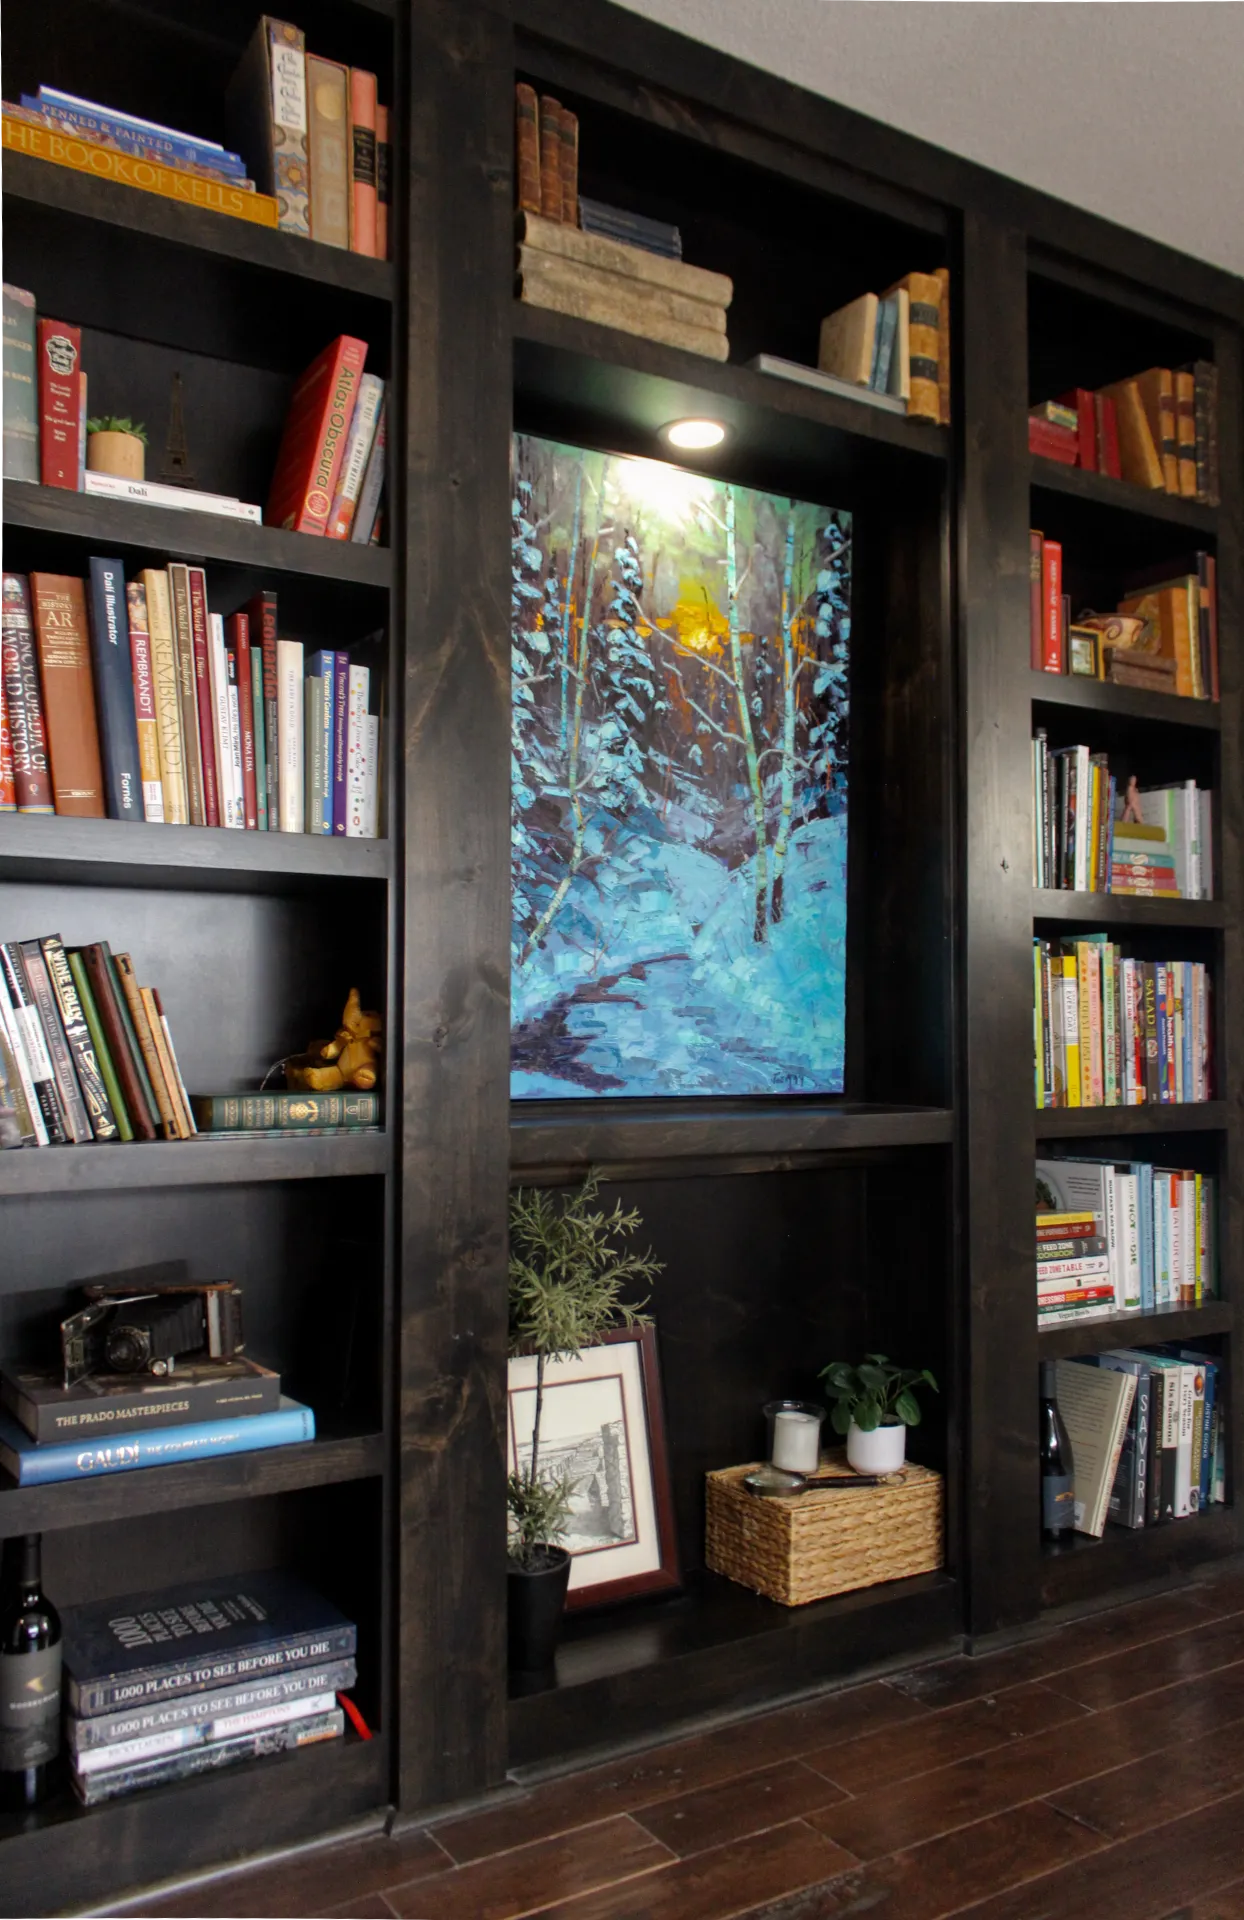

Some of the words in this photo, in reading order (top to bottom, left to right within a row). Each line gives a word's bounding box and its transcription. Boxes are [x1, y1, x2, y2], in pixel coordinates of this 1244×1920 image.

[41, 103, 97, 129] PENNED
[115, 126, 173, 152] PAINTED
[0, 119, 42, 153] HE
[49, 134, 132, 179] BOOK
[134, 163, 168, 191] OF
[173, 173, 244, 213] KELLS
[332, 366, 355, 411] Atlas
[316, 413, 346, 489] Obscura
[176, 588, 186, 602] The
[191, 590, 202, 604] The
[104, 594, 119, 646] Illustrator
[177, 604, 189, 632] World
[193, 607, 206, 633] World
[195, 633, 205, 645] of
[262, 601, 278, 699] Leonardo
[1, 629, 23, 696] WORLD
[135, 639, 153, 715] REMBRANDT
[181, 653, 193, 696] Rembrandt
[18, 631, 44, 750] ENCYCLOPEDIA
[323, 670, 332, 701] Vincent's
[154, 637, 182, 775] REMBRANDT
[219, 695, 227, 723] GUSTAV
[323, 701, 331, 729] Gardens
[8, 702, 32, 776] HISTORY
[221, 726, 229, 749] KLIMT
[244, 730, 253, 755] MONA
[120, 772, 134, 809] Fornés
[53, 949, 72, 984] WINE
[60, 986, 85, 1022] FOLLY
[1145, 978, 1156, 1026] SALAD
[46, 1015, 58, 1040] WINE
[1166, 1016, 1174, 1047] health
[1128, 1203, 1137, 1230] NOT
[1042, 1243, 1058, 1251] FEED
[1058, 1242, 1074, 1250] ZONE
[1130, 1243, 1138, 1267] DIE
[1062, 1262, 1083, 1272] TABLE
[1168, 1381, 1176, 1399] Six
[56, 1416, 78, 1427] THE
[79, 1410, 115, 1425] PRADO
[115, 1401, 190, 1418] MASTERPIECES
[1166, 1401, 1175, 1443] Seasons
[1203, 1401, 1211, 1432] JUSTINE
[1137, 1394, 1149, 1499] SAVOR
[1202, 1432, 1210, 1459] COOKS
[146, 1671, 192, 1693] PLACES
[193, 1667, 211, 1682] TO
[213, 1662, 236, 1678] SEE
[237, 1650, 284, 1673] BEFORE
[285, 1644, 309, 1661] YOU
[310, 1640, 330, 1656] DIE
[142, 1706, 189, 1729] PLACES
[190, 1701, 208, 1717] TO
[210, 1696, 234, 1712] SEE
[234, 1685, 281, 1707] BEFORE
[281, 1678, 306, 1695] YOU
[308, 1673, 328, 1689] DIE
